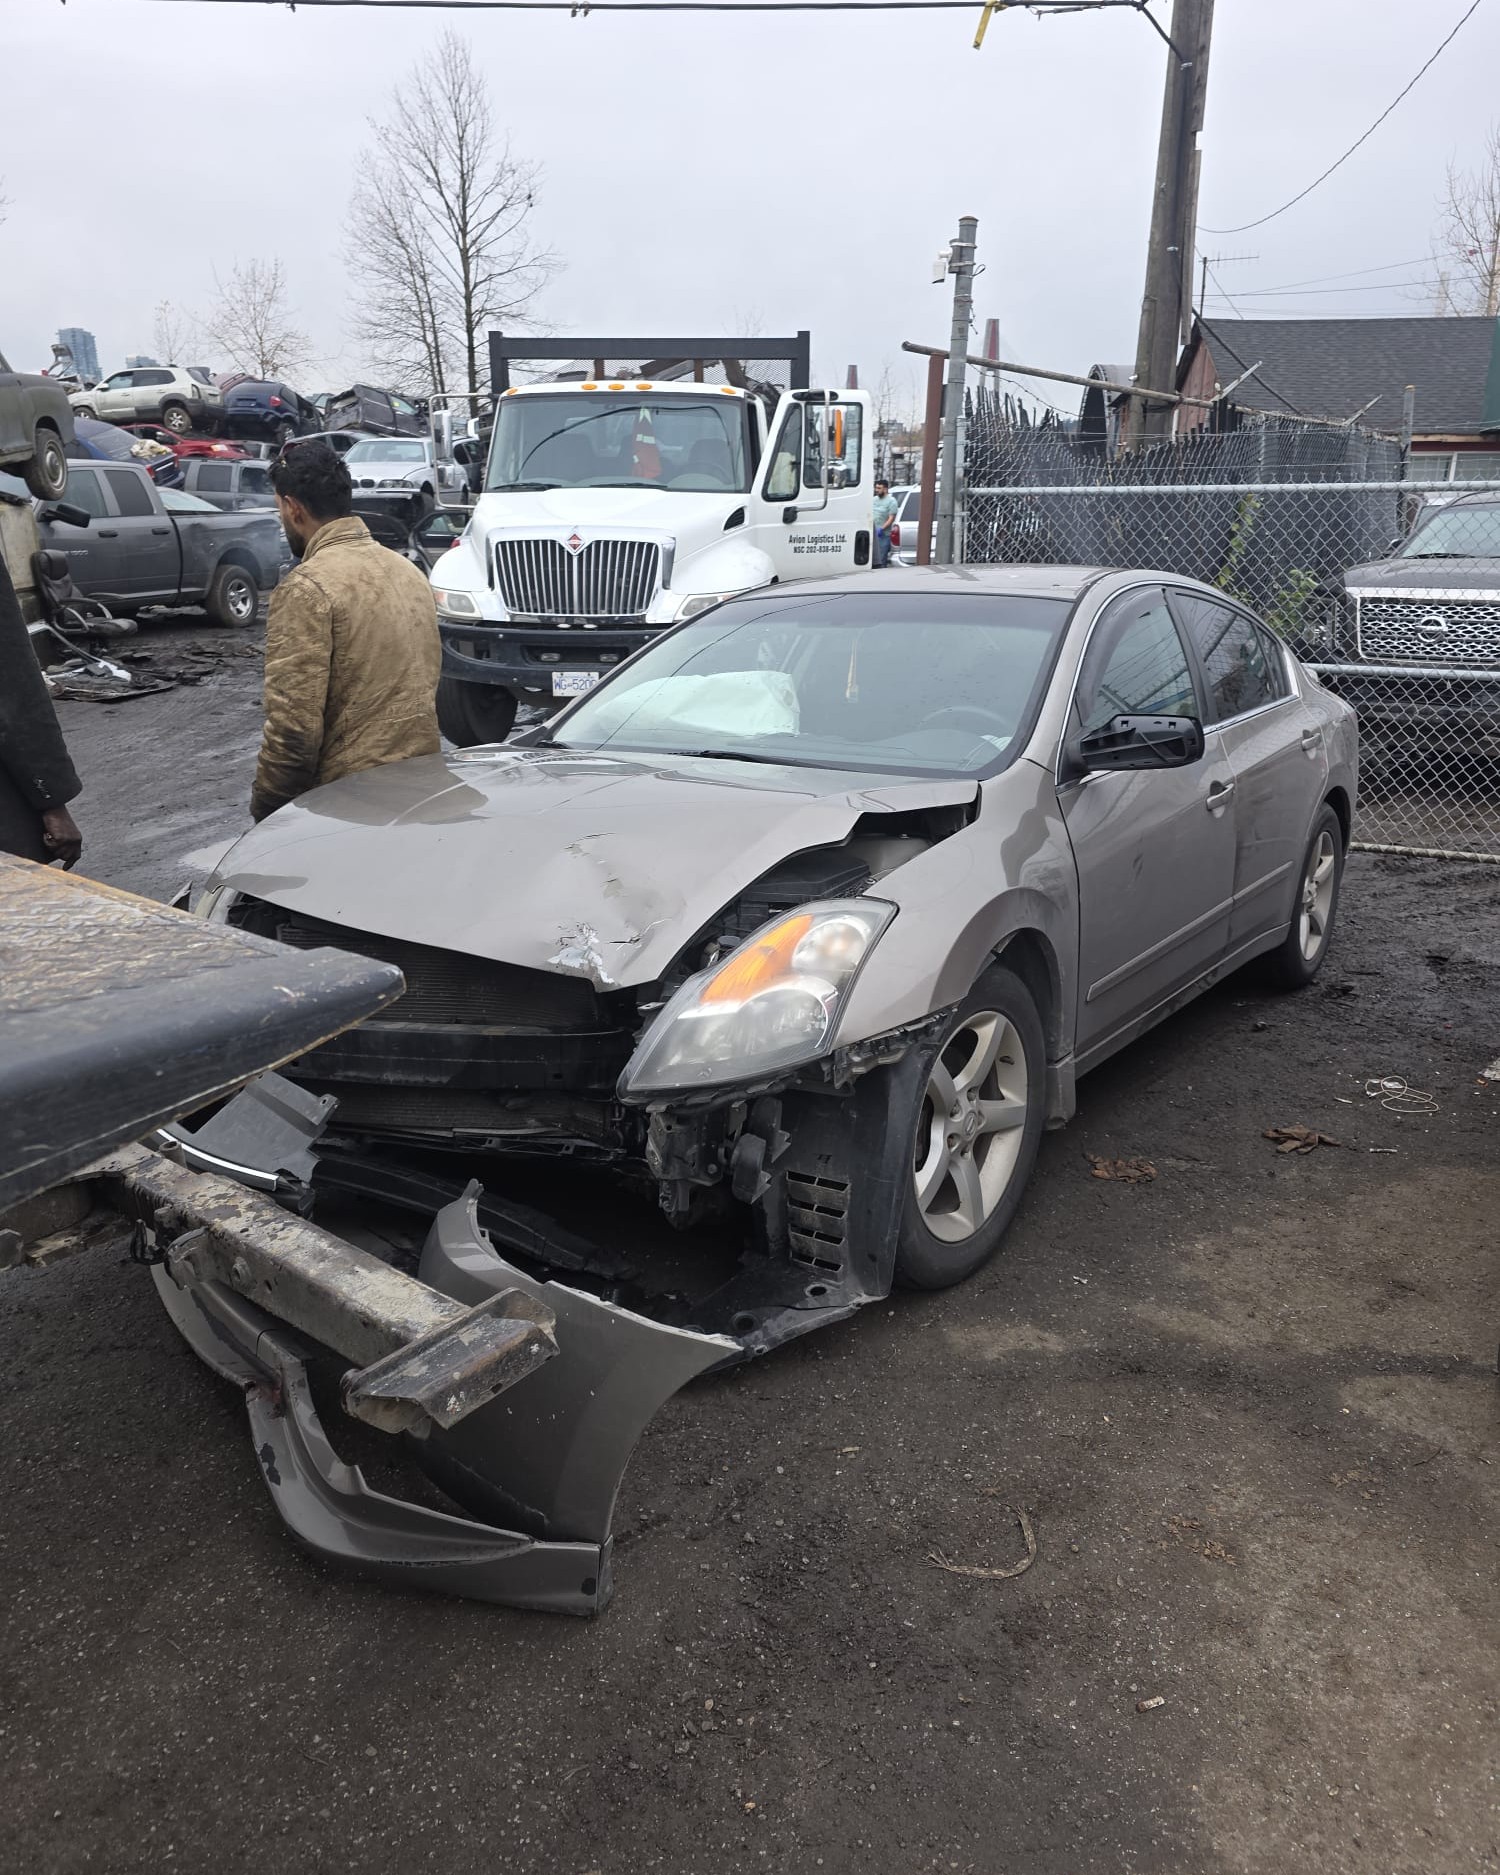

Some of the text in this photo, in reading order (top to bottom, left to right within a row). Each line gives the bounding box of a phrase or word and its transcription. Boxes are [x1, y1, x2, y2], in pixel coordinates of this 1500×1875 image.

[789, 533, 847, 545] Avion Logistics Ltd.
